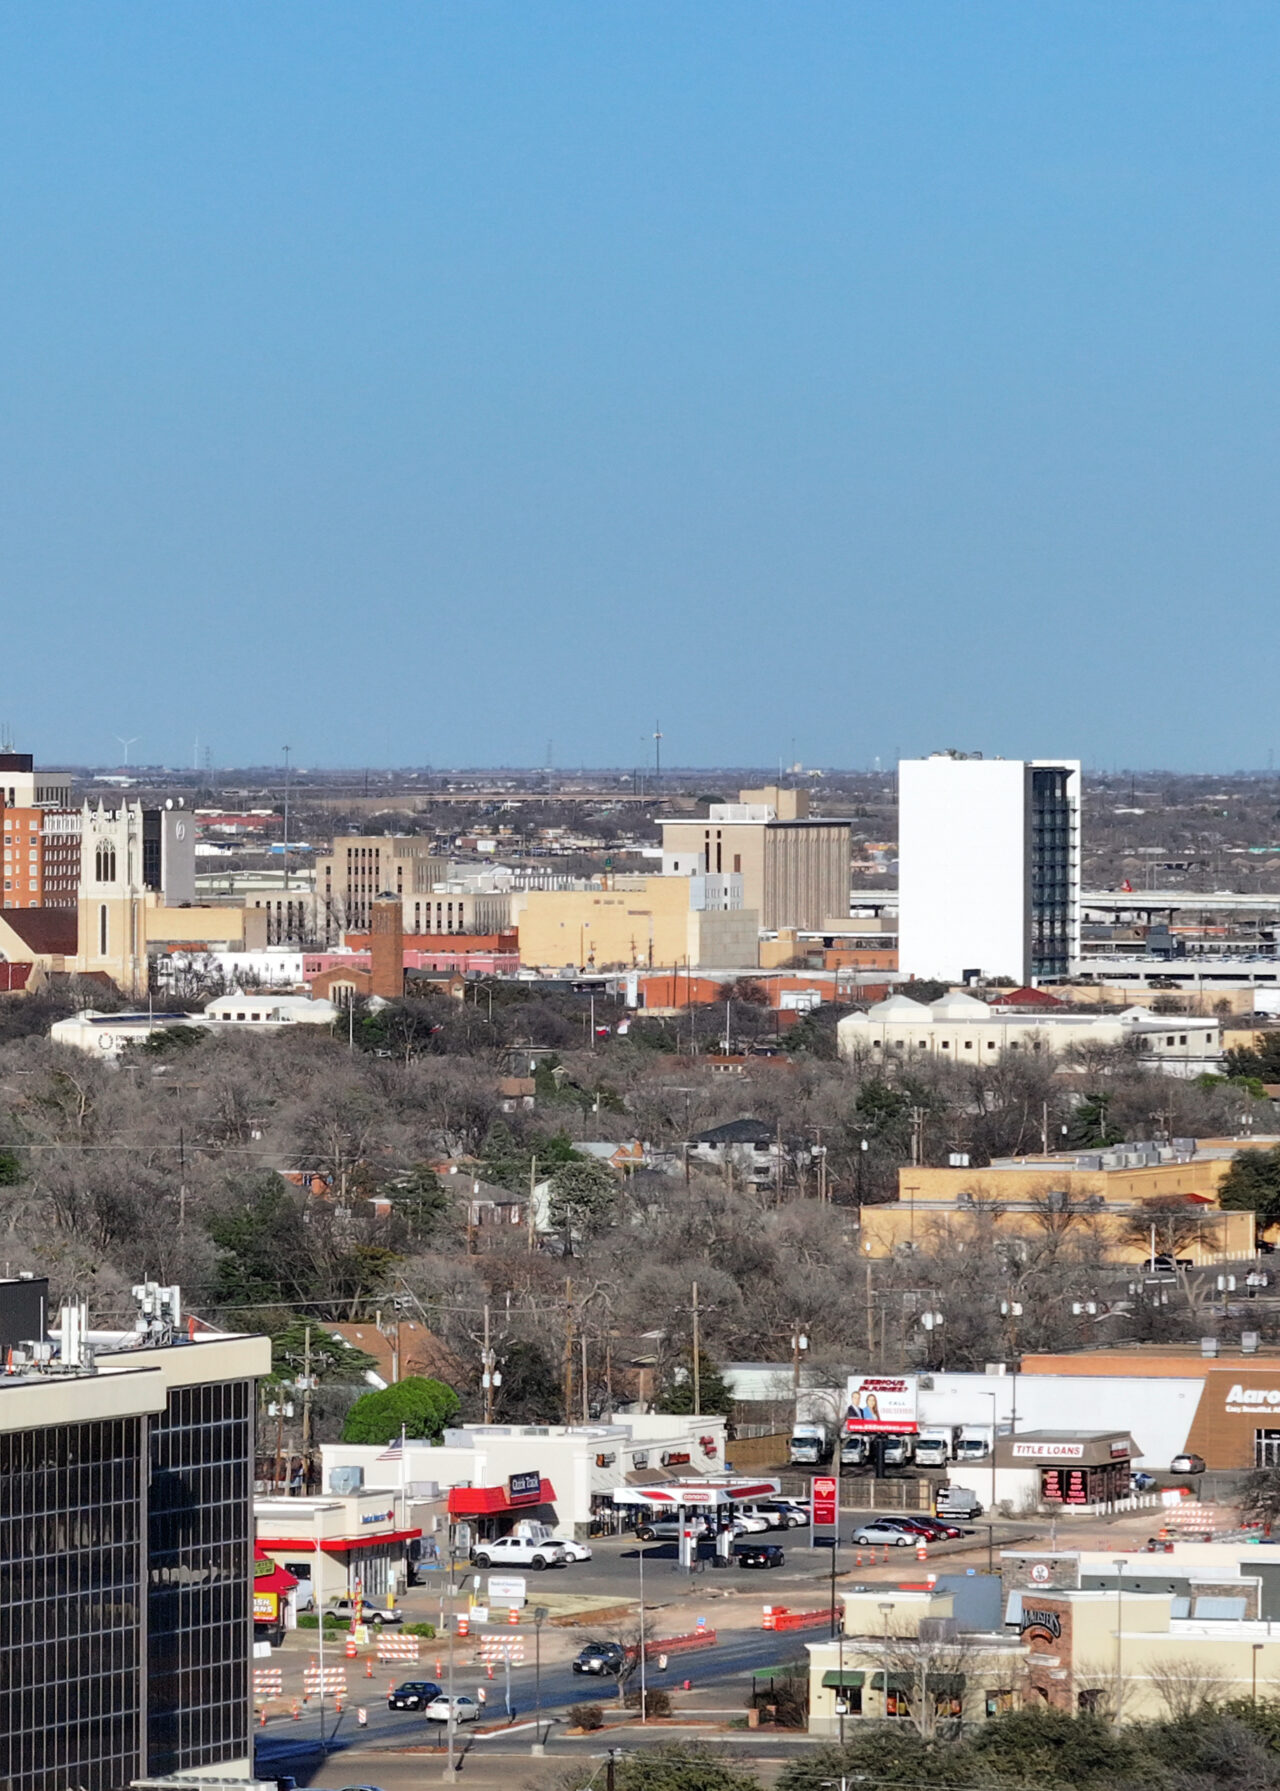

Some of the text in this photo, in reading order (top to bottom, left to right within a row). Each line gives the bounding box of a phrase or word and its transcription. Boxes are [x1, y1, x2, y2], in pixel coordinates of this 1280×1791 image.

[863, 1379, 906, 1387] SERIOUS
[1016, 1445, 1081, 1456] TITLE LOANS
